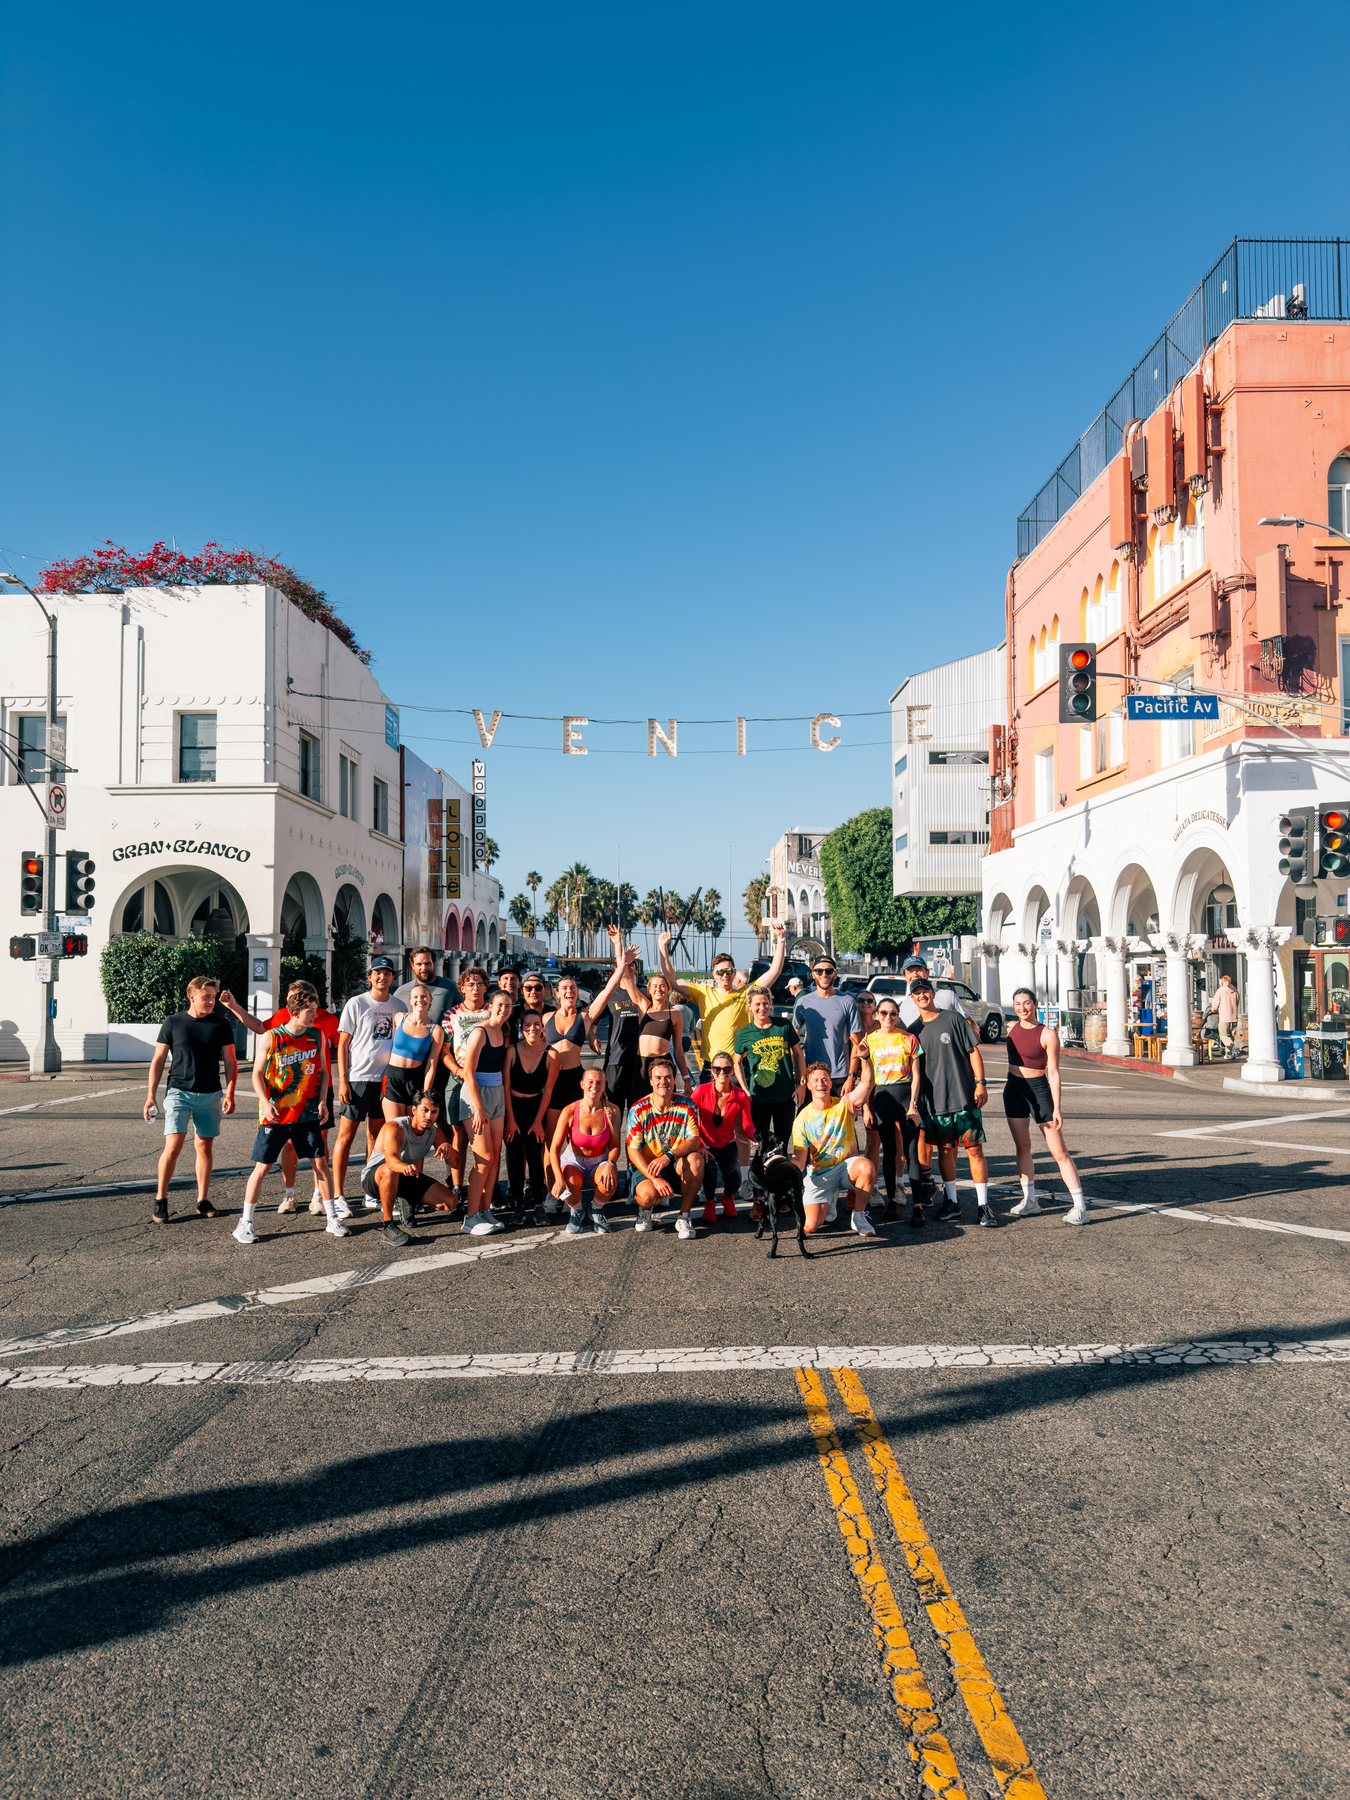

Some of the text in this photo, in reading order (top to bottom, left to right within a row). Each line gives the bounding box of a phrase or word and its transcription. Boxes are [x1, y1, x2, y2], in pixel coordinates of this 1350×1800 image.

[1134, 700, 1212, 714] Pacific Av
[472, 704, 933, 757] VENICE
[475, 764, 485, 858] VOODOO
[112, 839, 251, 863] GRAN BLANCO
[788, 860, 819, 878] NEVER
[40, 943, 49, 953] OK
[751, 1035, 784, 1049] LITHUANIA
